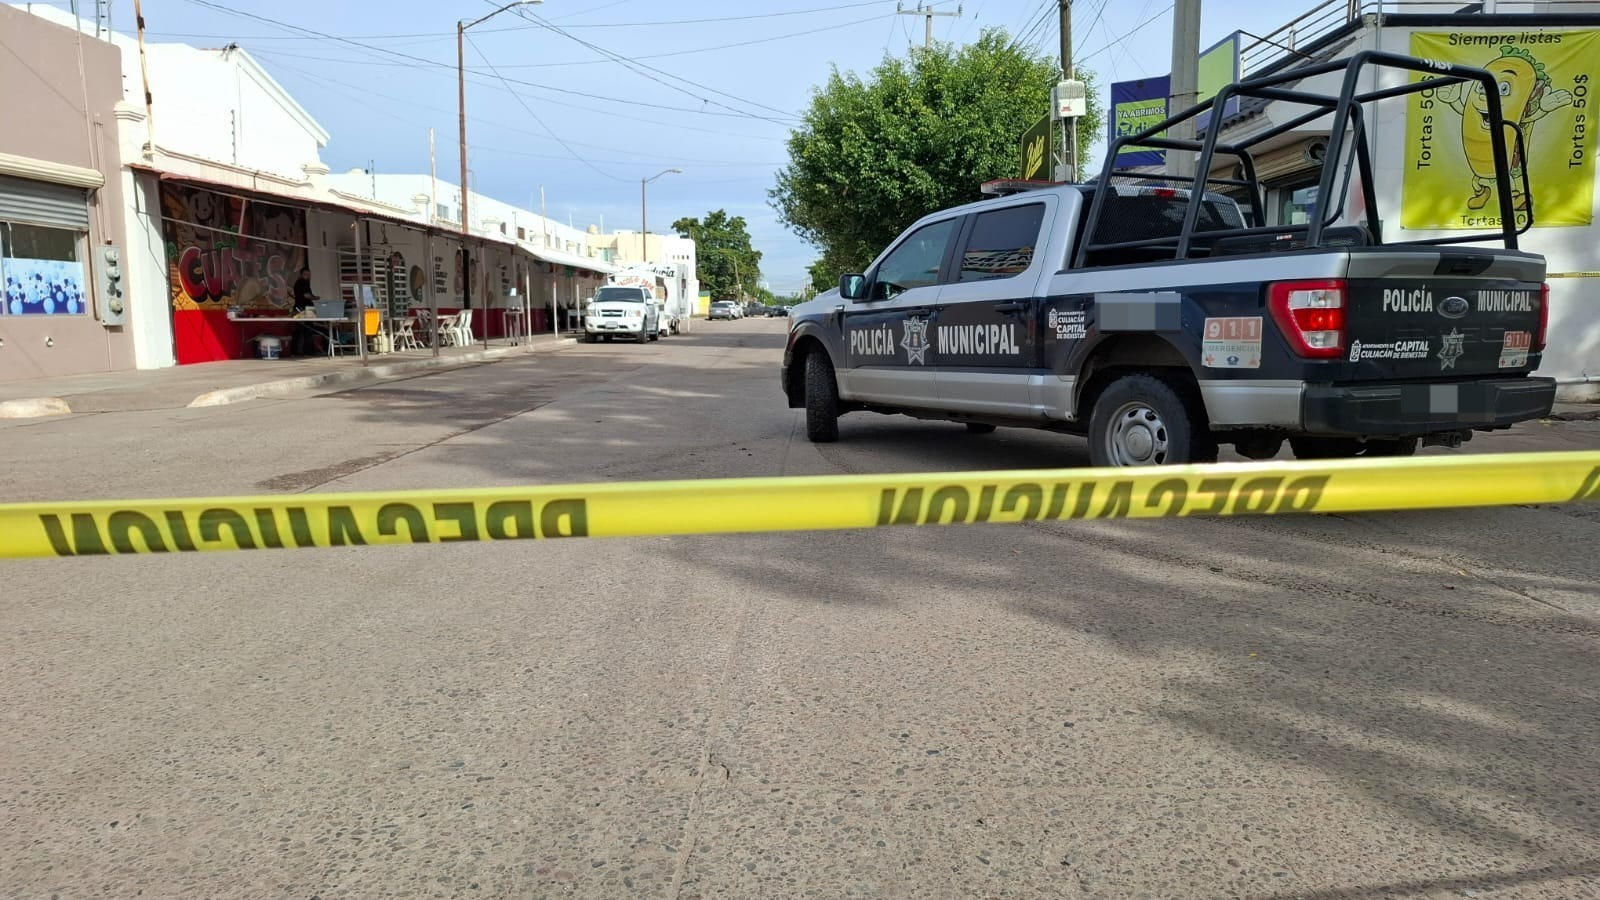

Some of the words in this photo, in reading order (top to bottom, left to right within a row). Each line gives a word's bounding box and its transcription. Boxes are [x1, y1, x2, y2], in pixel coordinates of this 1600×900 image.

[1449, 33, 1516, 48] Siempre
[1520, 32, 1562, 44] listas
[1573, 74, 1589, 109] 50$
[1118, 109, 1128, 119] YA
[1130, 106, 1166, 117] ABRIMOS
[1417, 116, 1433, 170] Tortas
[1569, 116, 1586, 169] Tortas
[1461, 215, 1503, 226] Tortas
[179, 243, 287, 307] CUATES
[1383, 284, 1433, 313] POLICÍA
[1477, 290, 1532, 313] MUNICIPAL
[1056, 324, 1087, 334] CAPITAL
[1208, 320, 1256, 338] 911
[850, 323, 895, 355] POLICÍA
[938, 324, 1020, 355] MUNICIPAL
[1394, 340, 1430, 352] CAPITAL
[1505, 334, 1529, 347] 911
[1360, 347, 1393, 359] CULIACÁN
